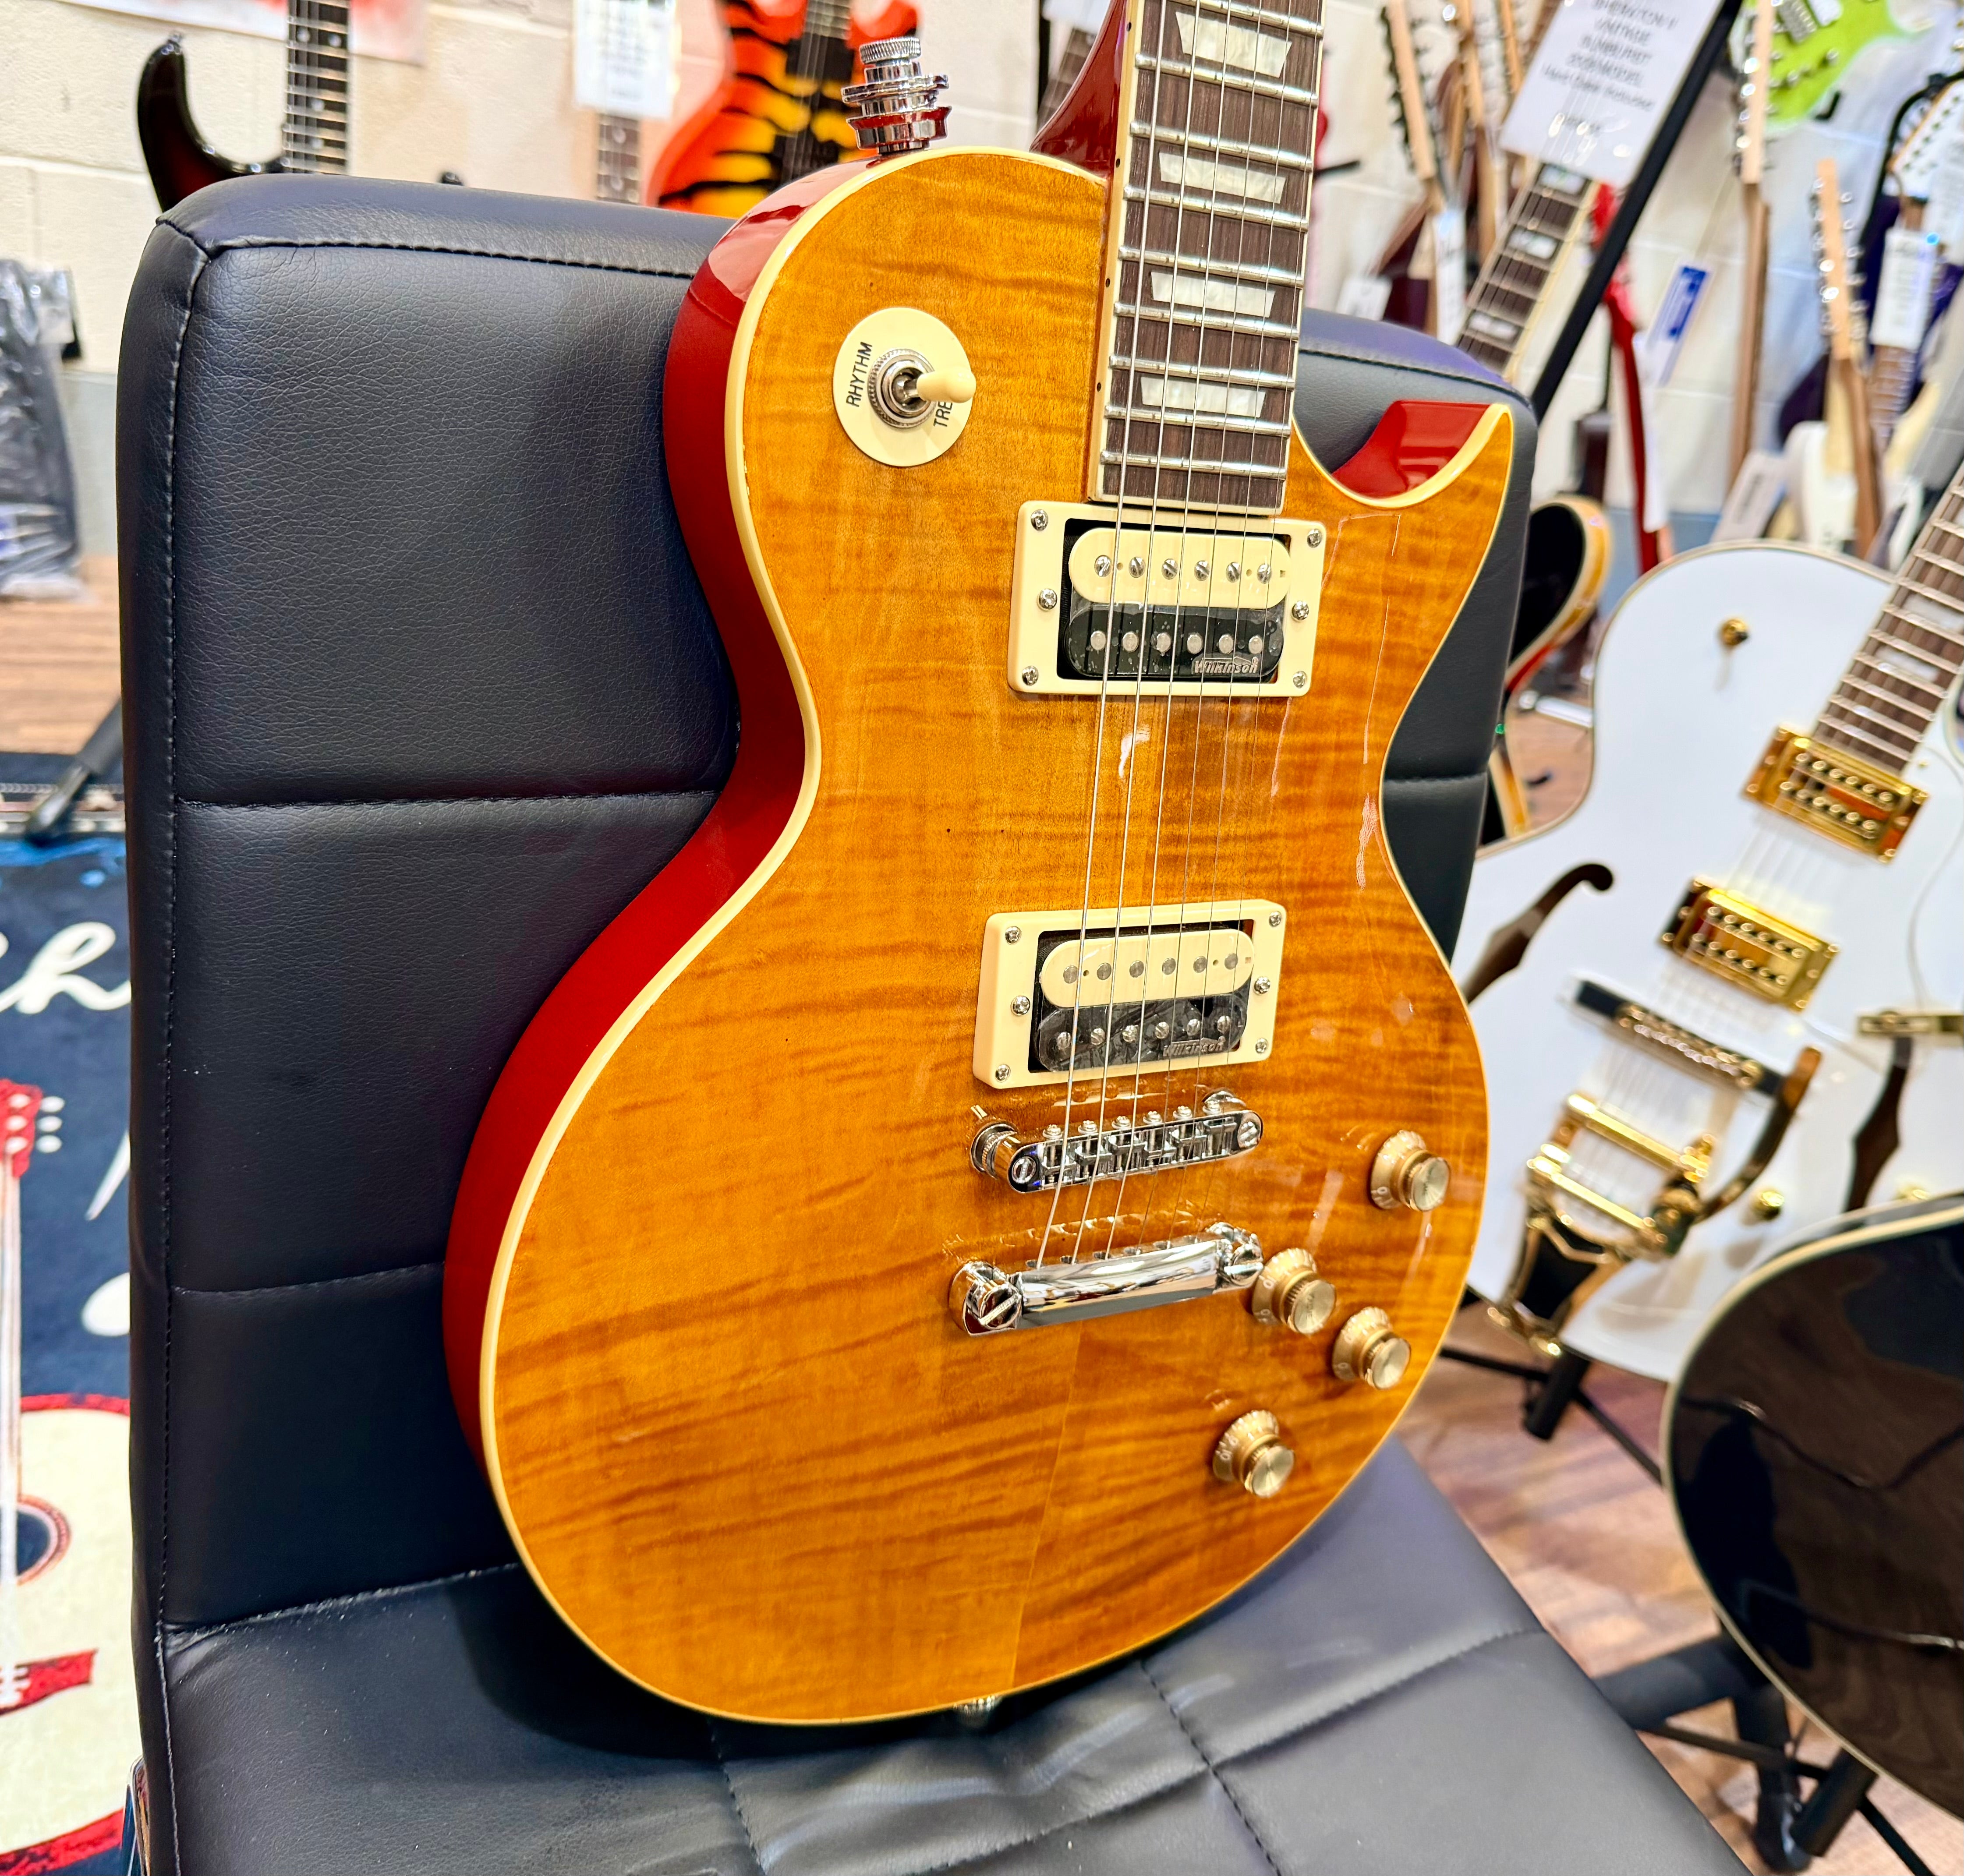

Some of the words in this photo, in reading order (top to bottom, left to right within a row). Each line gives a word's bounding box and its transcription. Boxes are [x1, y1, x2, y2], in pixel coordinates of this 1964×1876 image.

[846, 341, 873, 407] RHYTHM
[933, 401, 953, 427] TRE
[1195, 657, 1259, 674] Wilkinson
[1163, 1041, 1224, 1057] Wilkinson
